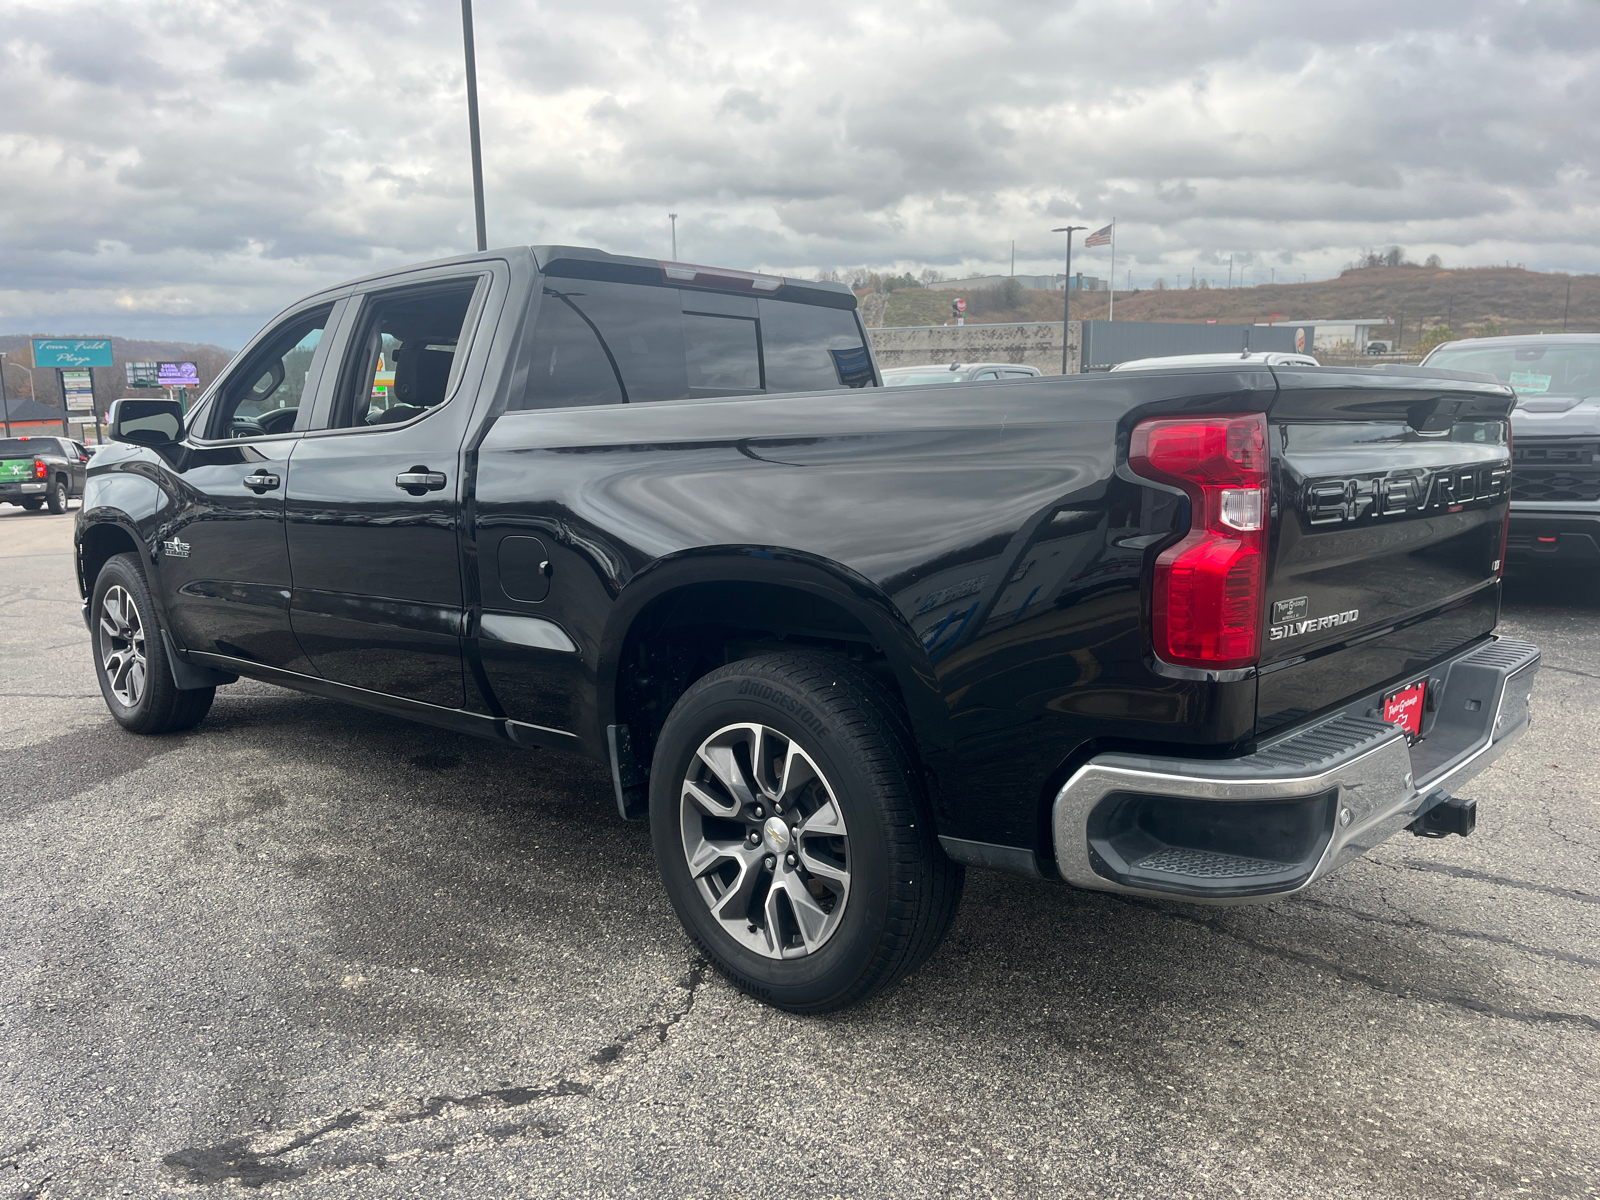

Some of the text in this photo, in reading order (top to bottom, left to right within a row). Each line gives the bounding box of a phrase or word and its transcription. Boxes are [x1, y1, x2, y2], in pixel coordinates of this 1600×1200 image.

[38, 340, 106, 352] Town Field
[56, 352, 91, 366] Plaza
[1309, 469, 1511, 525] CHEVROLET
[1268, 609, 1359, 641] SILVERADO
[737, 679, 830, 739] BRIDGESTONE
